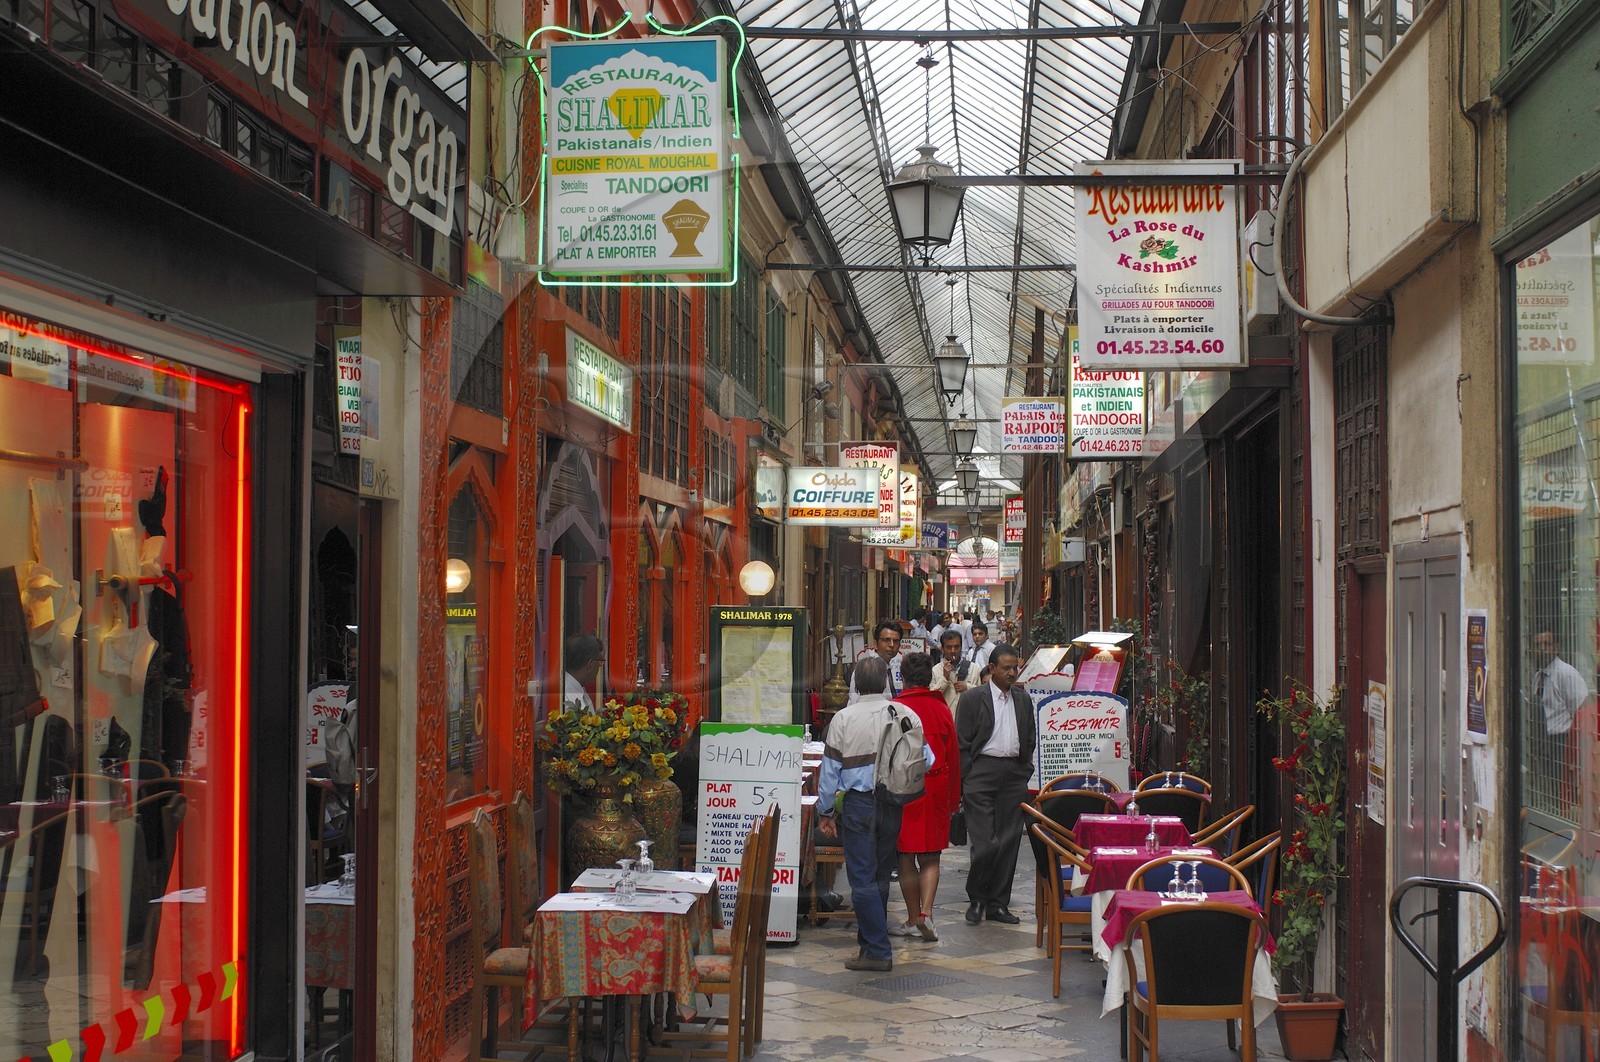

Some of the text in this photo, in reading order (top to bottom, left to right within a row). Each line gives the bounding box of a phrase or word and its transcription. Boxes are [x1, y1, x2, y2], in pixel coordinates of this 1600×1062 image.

[562, 68, 704, 96] RESTAURANT
[557, 93, 713, 132] SHALIMAR
[556, 154, 710, 171] CUISNE ROYAL MOUGHAL
[605, 175, 709, 195] TANDOORI
[600, 214, 656, 222] GASTRONOMIE
[557, 224, 657, 242] Tel. 01.45.23.31.61
[1108, 220, 1205, 243] La Rose du
[557, 246, 657, 260] PLAT A EMPORTER
[1117, 253, 1198, 274] Kashmir
[1095, 282, 1223, 298] Spécialités Indiennes
[1102, 301, 1140, 309] GRILLADES
[1176, 300, 1215, 308] TANDOORI
[1113, 315, 1204, 324] Plats à emporter
[1104, 325, 1214, 334] Livraison à domicile
[1096, 339, 1225, 355] 01.45.23.54.60
[574, 337, 623, 386] RESTAURANT
[567, 360, 629, 427] SHALIMAR
[1073, 387, 1144, 398] PAKISTANAIS
[1081, 401, 1133, 411] et INDIEN
[1004, 411, 1045, 420] PALAIS
[1073, 413, 1142, 426] TANDOORI
[1004, 422, 1066, 434] RAJPOUT
[1110, 427, 1142, 435] GASTRONOMIE
[845, 449, 894, 458] RESTAURANT
[811, 472, 857, 490] Oujda
[793, 488, 874, 503] COIFFURE
[792, 509, 875, 518] 01.45.23.43.02
[720, 611, 772, 620] SHALIMAR
[1050, 700, 1117, 717] La ROSE du
[1046, 717, 1121, 732] KASHMIR
[706, 783, 733, 793] PLAT
[706, 797, 737, 808] JOUR
